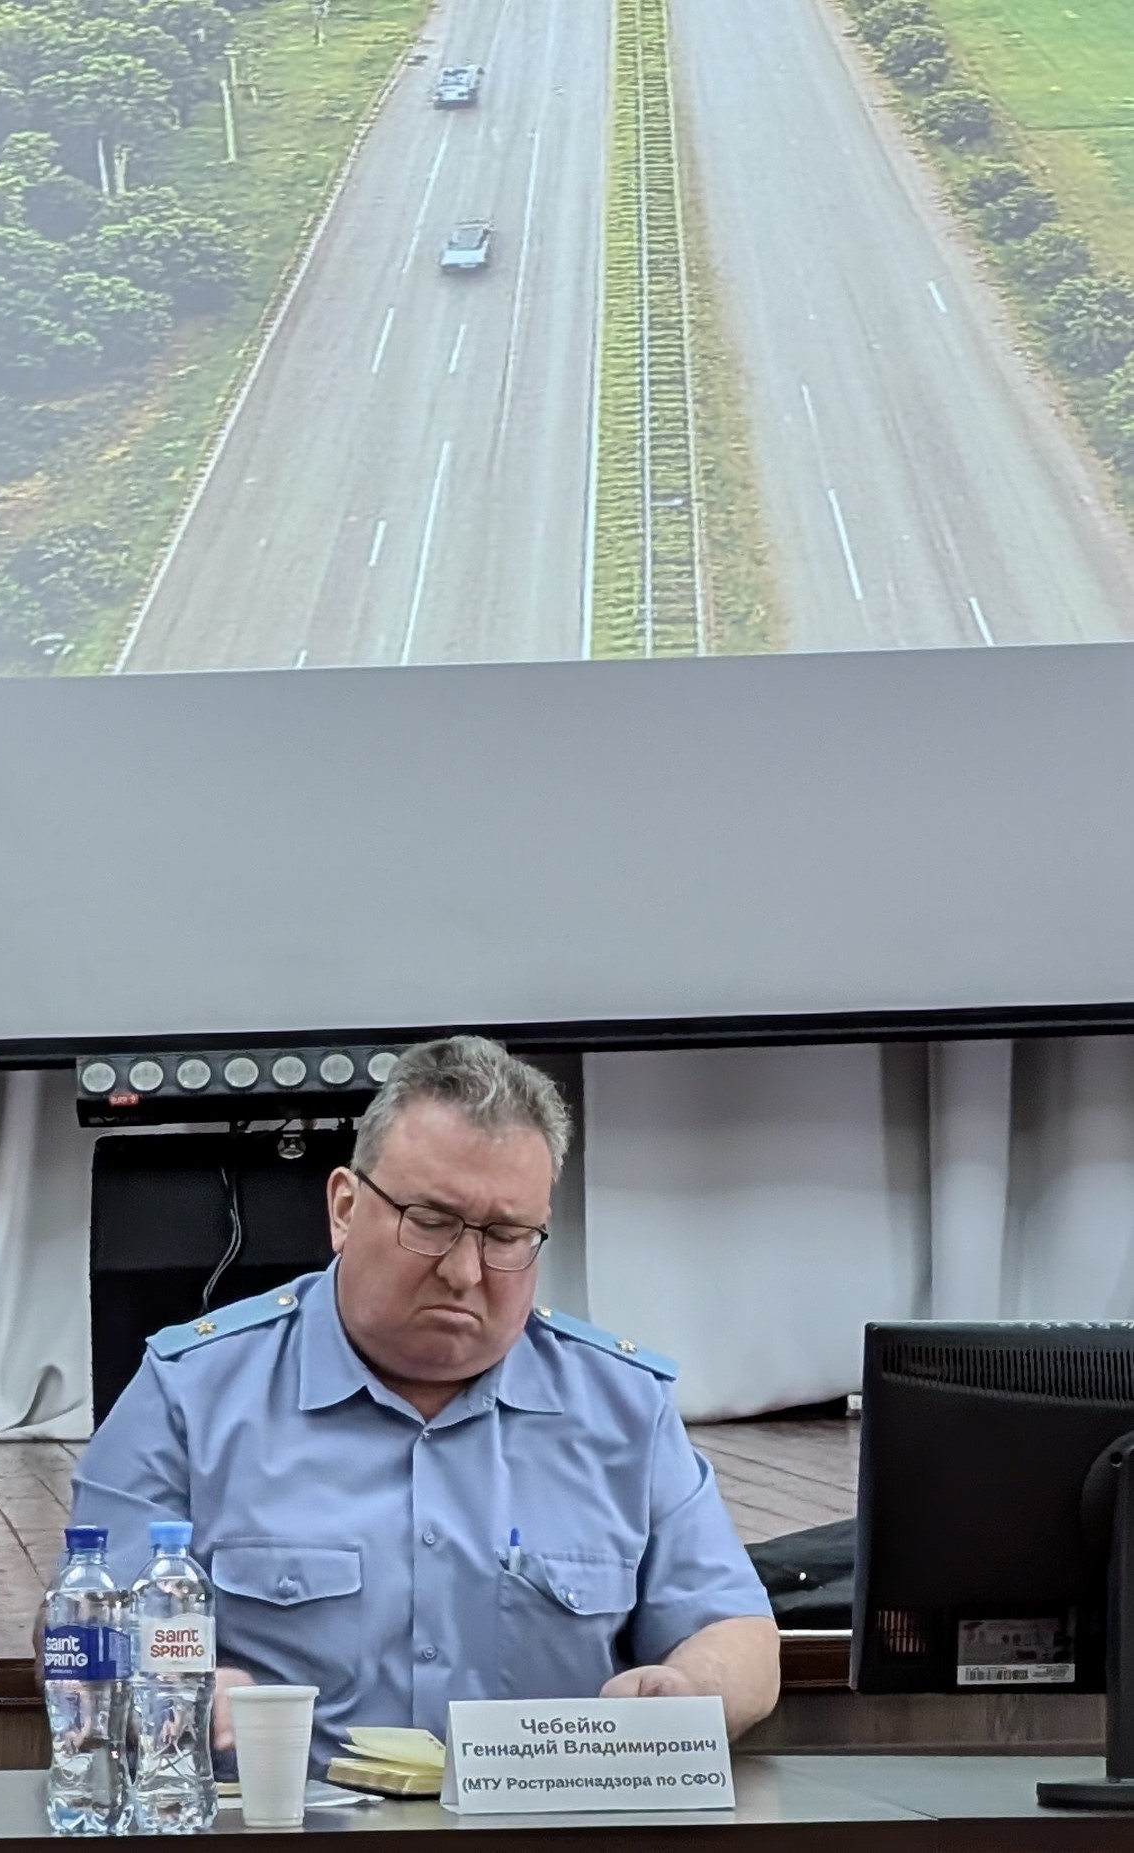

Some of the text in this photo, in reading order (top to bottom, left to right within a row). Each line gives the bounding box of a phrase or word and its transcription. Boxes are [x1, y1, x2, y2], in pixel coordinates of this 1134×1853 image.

[150, 1644, 205, 1658] SPRING
[520, 1717, 617, 1736] Чебейко
[461, 1737, 717, 1759] Геннадий Владимирович
[462, 1772, 727, 1794] (МТУ Ространснадзора по СФО)
